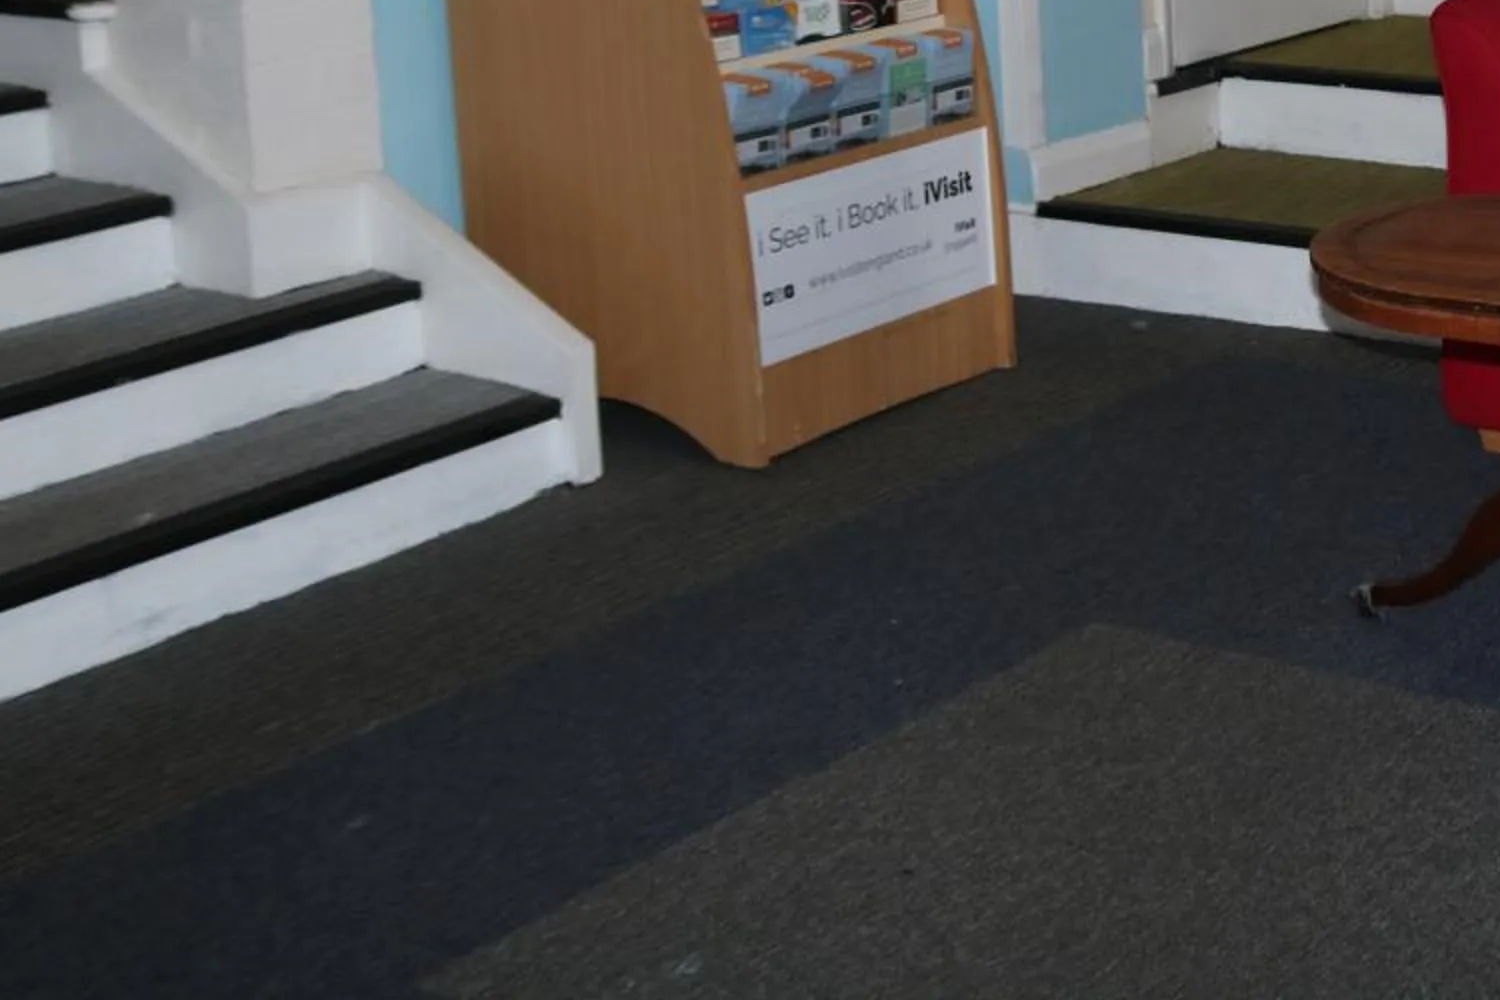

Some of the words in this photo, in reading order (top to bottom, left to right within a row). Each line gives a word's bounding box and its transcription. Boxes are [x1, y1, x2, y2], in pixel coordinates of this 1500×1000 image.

[768, 224, 810, 253] See
[836, 208, 843, 232] i
[847, 193, 899, 229] Book
[923, 170, 973, 206] iVisit
